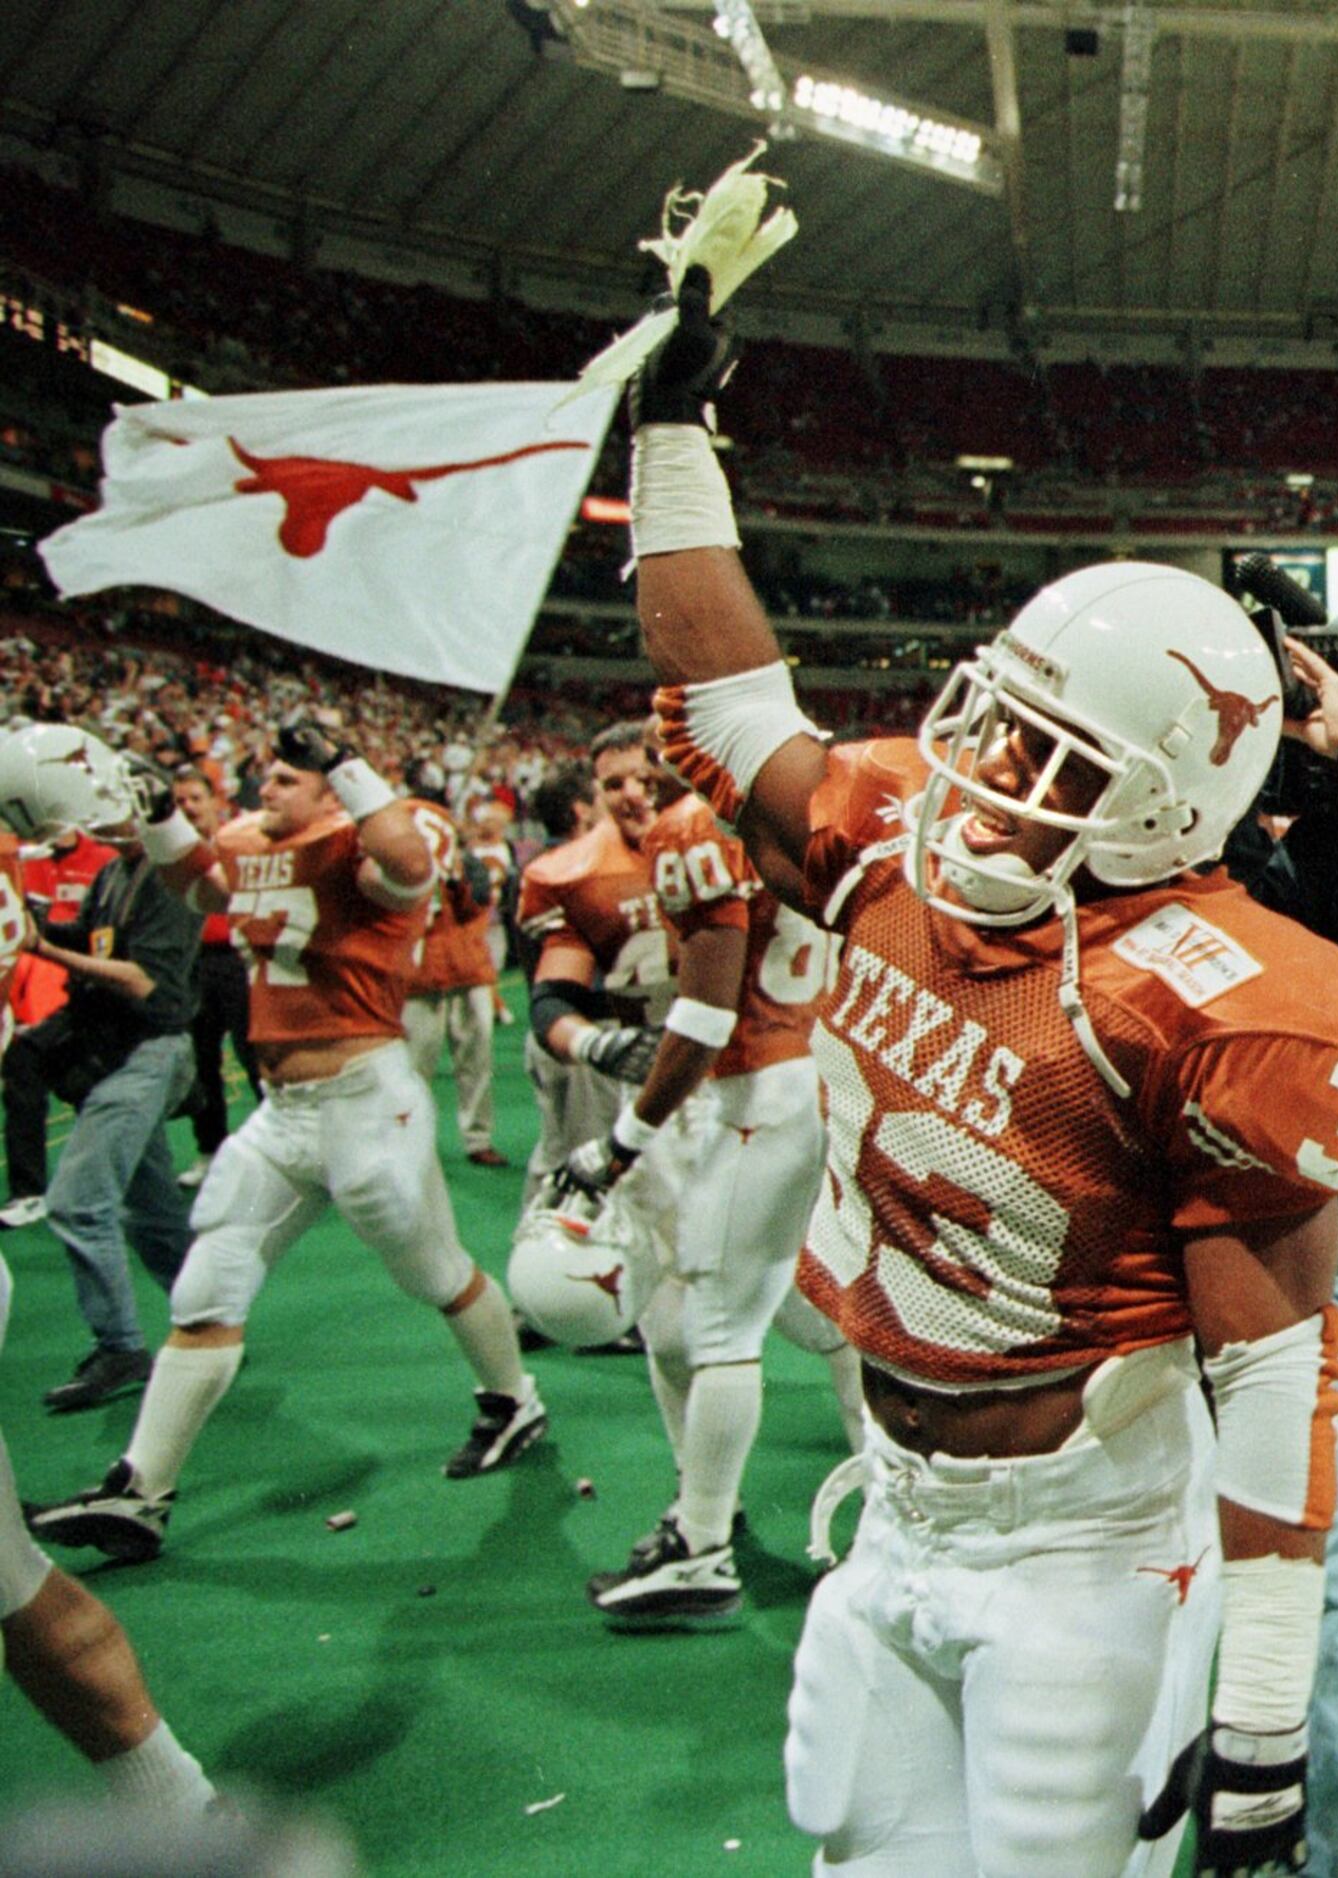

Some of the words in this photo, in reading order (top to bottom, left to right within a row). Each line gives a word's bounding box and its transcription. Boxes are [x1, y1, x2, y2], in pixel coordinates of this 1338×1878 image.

[235, 850, 296, 890] TEXAS
[655, 840, 734, 912] 80
[831, 944, 1028, 1138] TEXAS
